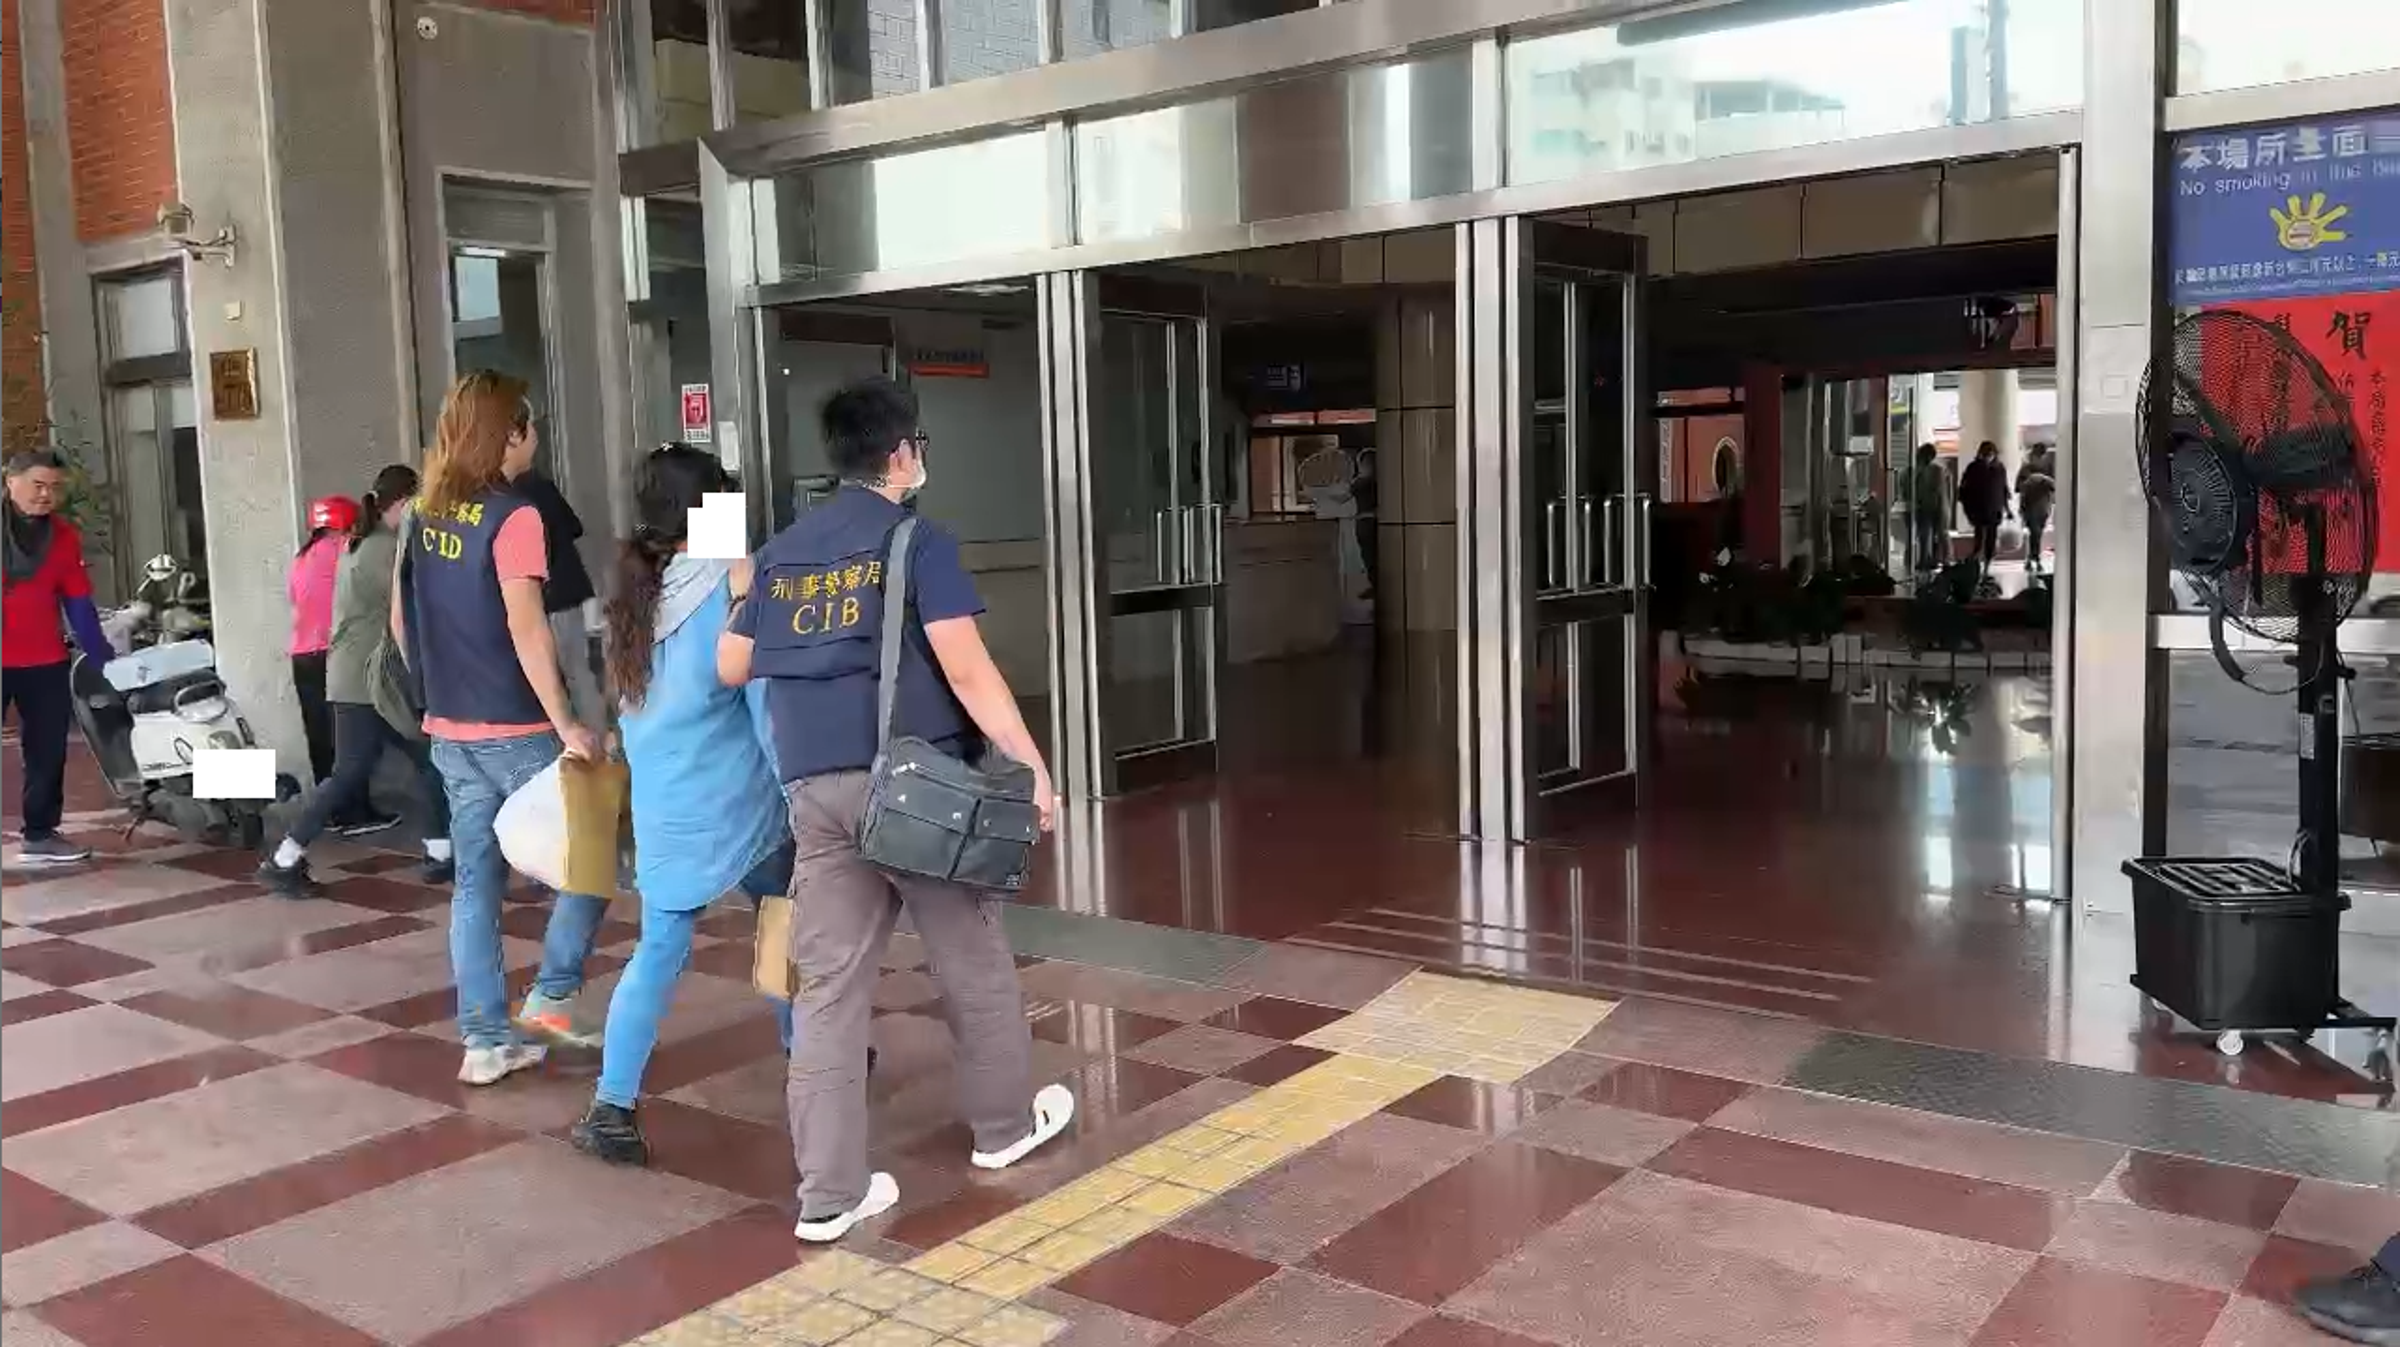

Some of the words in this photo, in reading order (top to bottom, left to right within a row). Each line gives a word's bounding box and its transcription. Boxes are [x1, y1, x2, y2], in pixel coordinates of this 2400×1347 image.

[2180, 180, 2205, 196] No
[2215, 172, 2291, 193] smoking
[2325, 310, 2372, 361] 賀
[422, 527, 462, 559] CID
[771, 561, 881, 600] 刑事警察局
[792, 597, 860, 634] CIB
